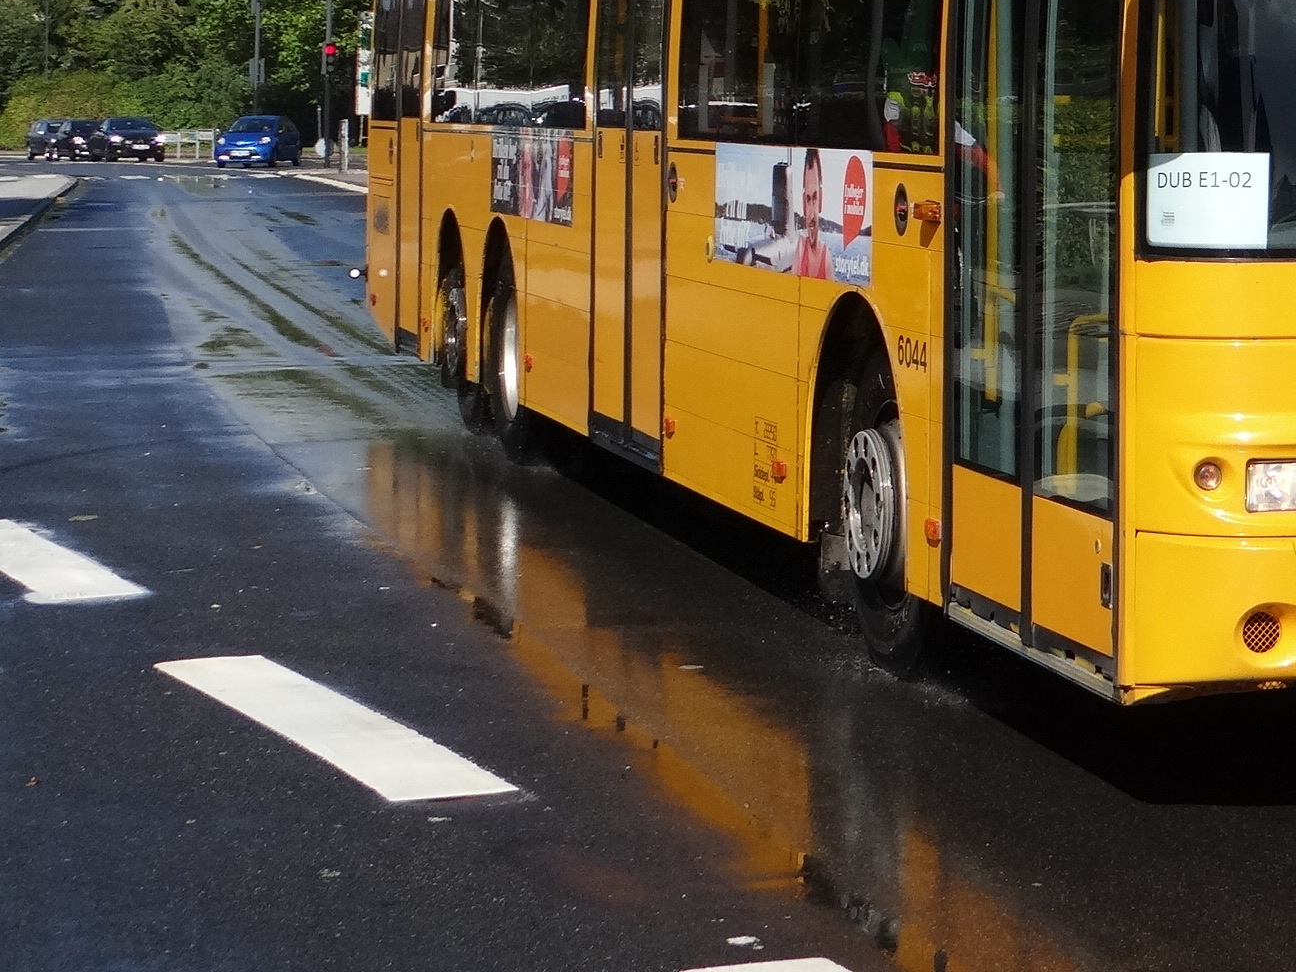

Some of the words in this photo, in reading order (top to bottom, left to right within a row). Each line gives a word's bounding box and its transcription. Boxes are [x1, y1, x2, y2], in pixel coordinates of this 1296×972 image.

[1157, 171, 1192, 188] DUB
[1199, 171, 1252, 188] E1-02
[835, 254, 870, 279] storytel.dk
[897, 334, 927, 373] 6044
